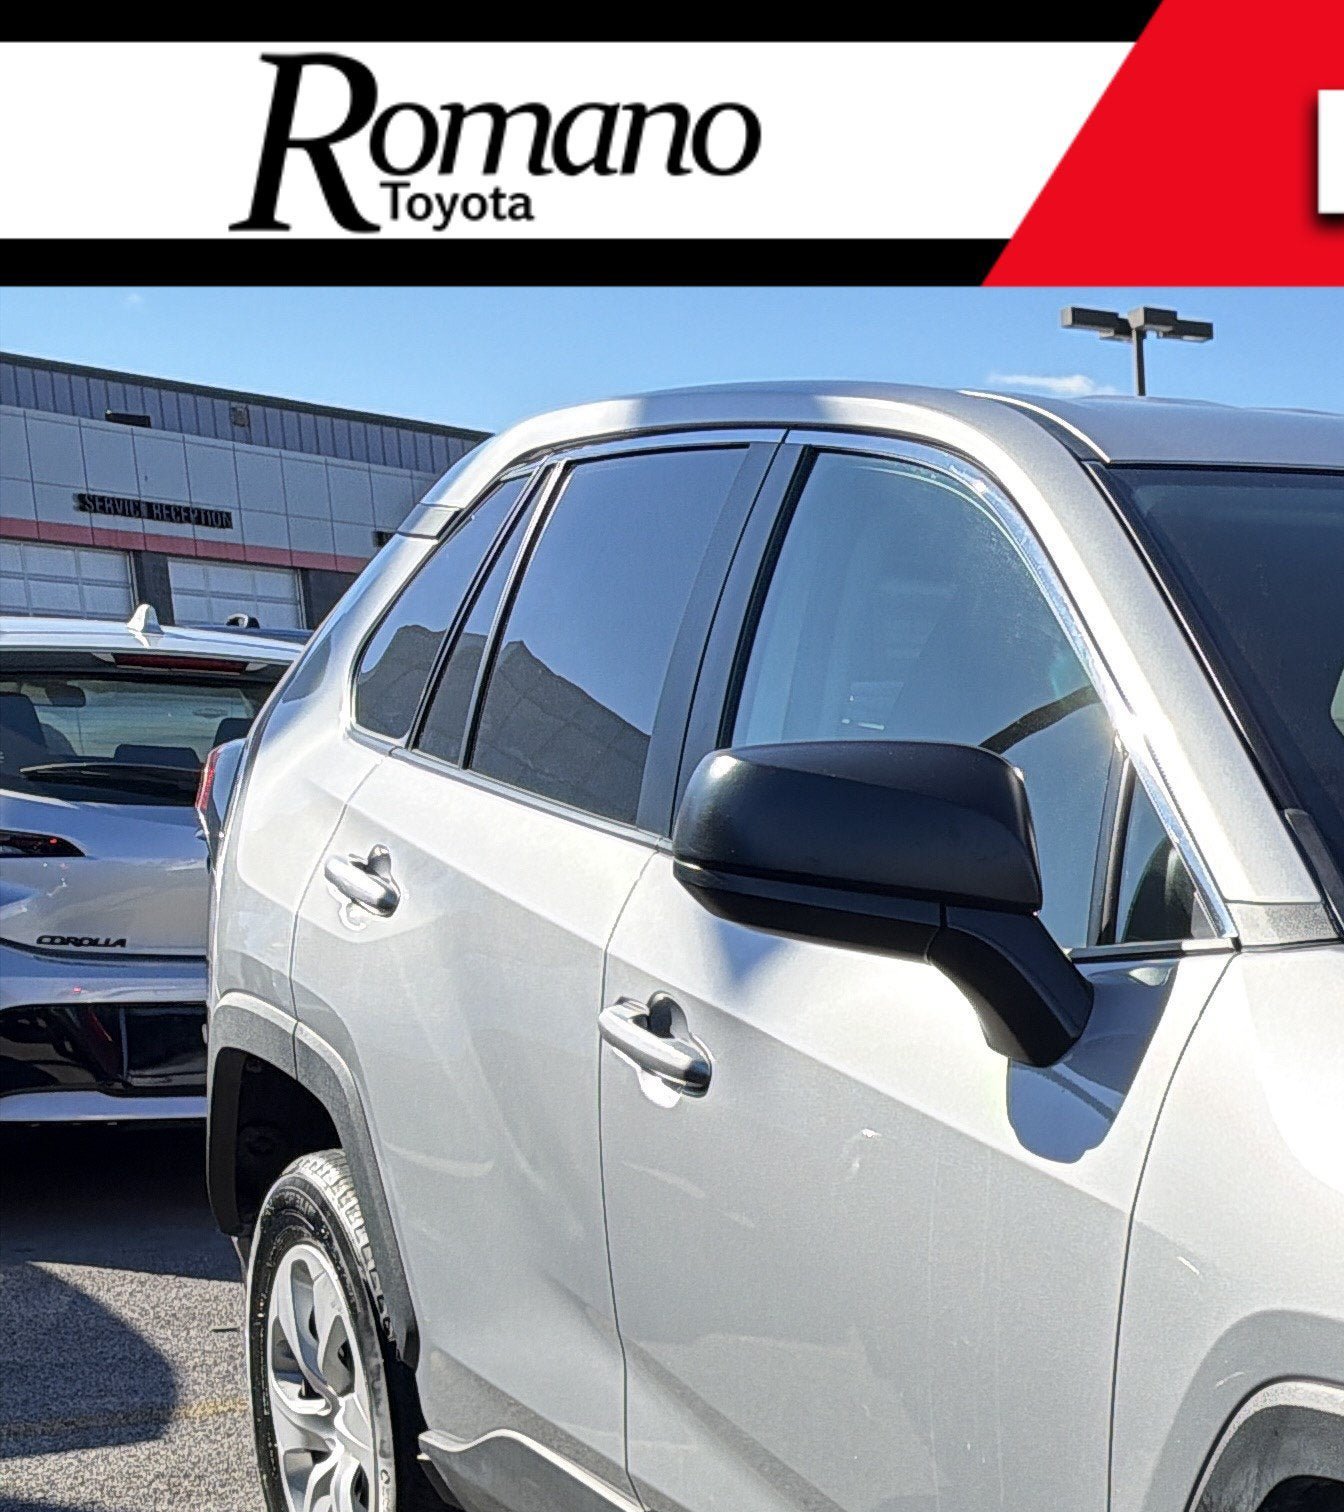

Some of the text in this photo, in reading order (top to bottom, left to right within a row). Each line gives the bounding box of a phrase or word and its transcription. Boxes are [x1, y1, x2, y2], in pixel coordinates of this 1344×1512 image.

[83, 493, 233, 529] SERVICE RECEPTION
[36, 934, 127, 948] COROLLA
